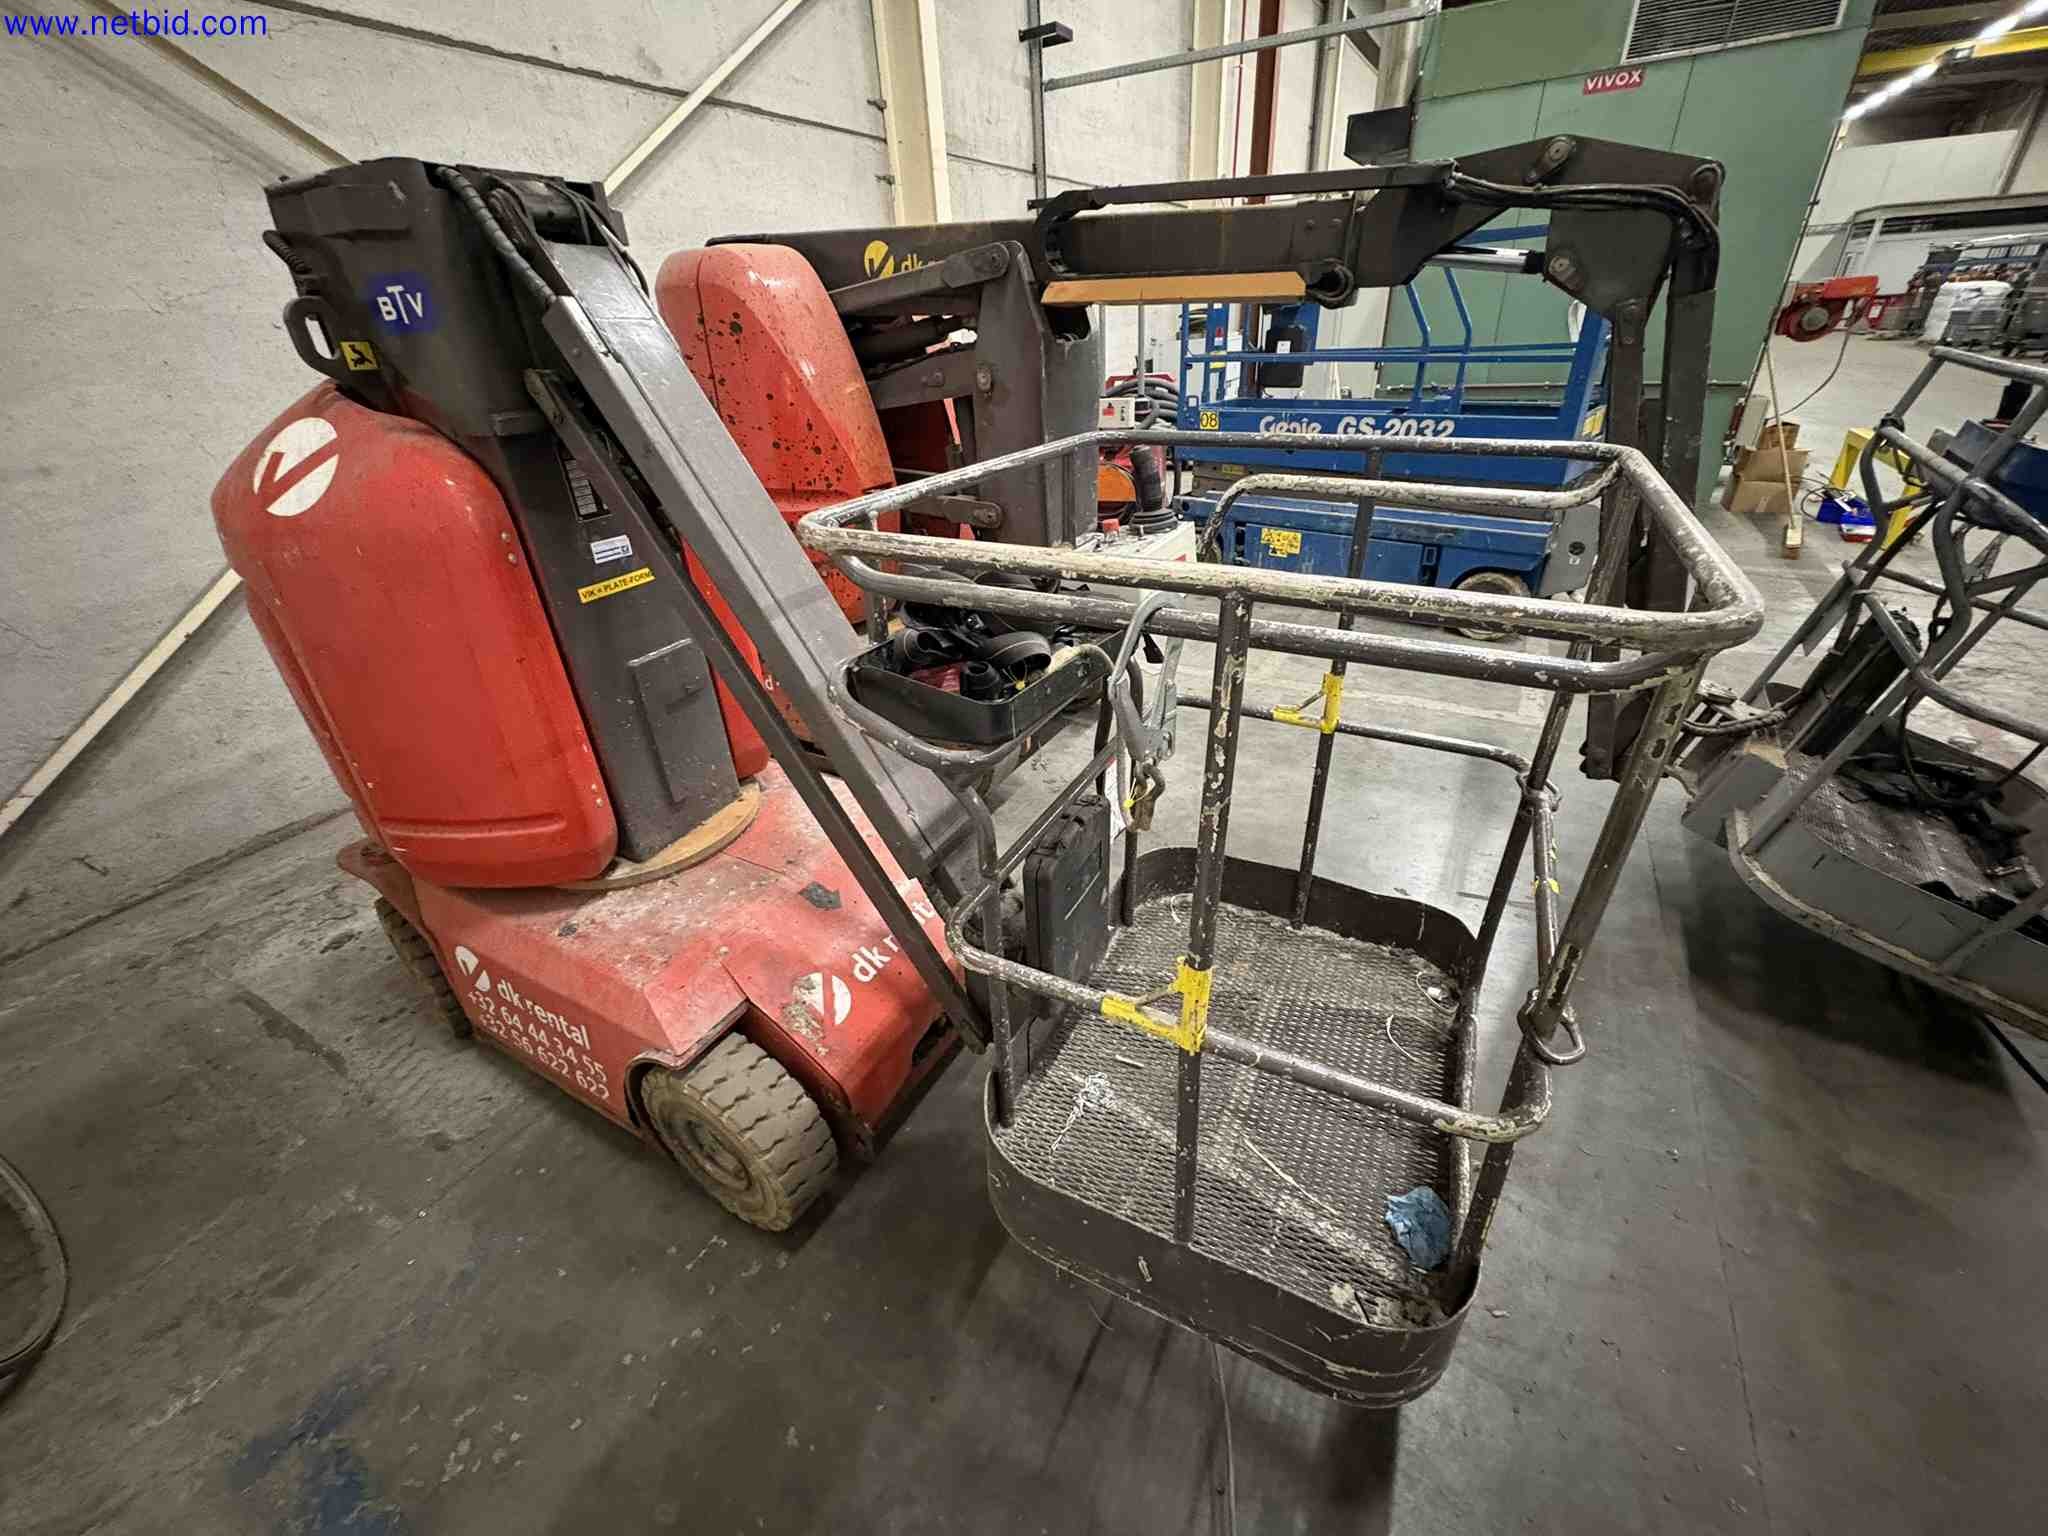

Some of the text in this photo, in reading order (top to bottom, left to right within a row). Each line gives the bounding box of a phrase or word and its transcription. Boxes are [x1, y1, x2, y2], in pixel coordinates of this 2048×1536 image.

[1586, 69, 1642, 91] VIVOX
[376, 284, 424, 325] BTV
[1200, 411, 1218, 428] 08
[1259, 415, 1456, 438] Genie GS-2032
[852, 945, 892, 982] dk
[496, 978, 591, 1051] dk rental
[467, 990, 607, 1083] +32 64 44 34 55
